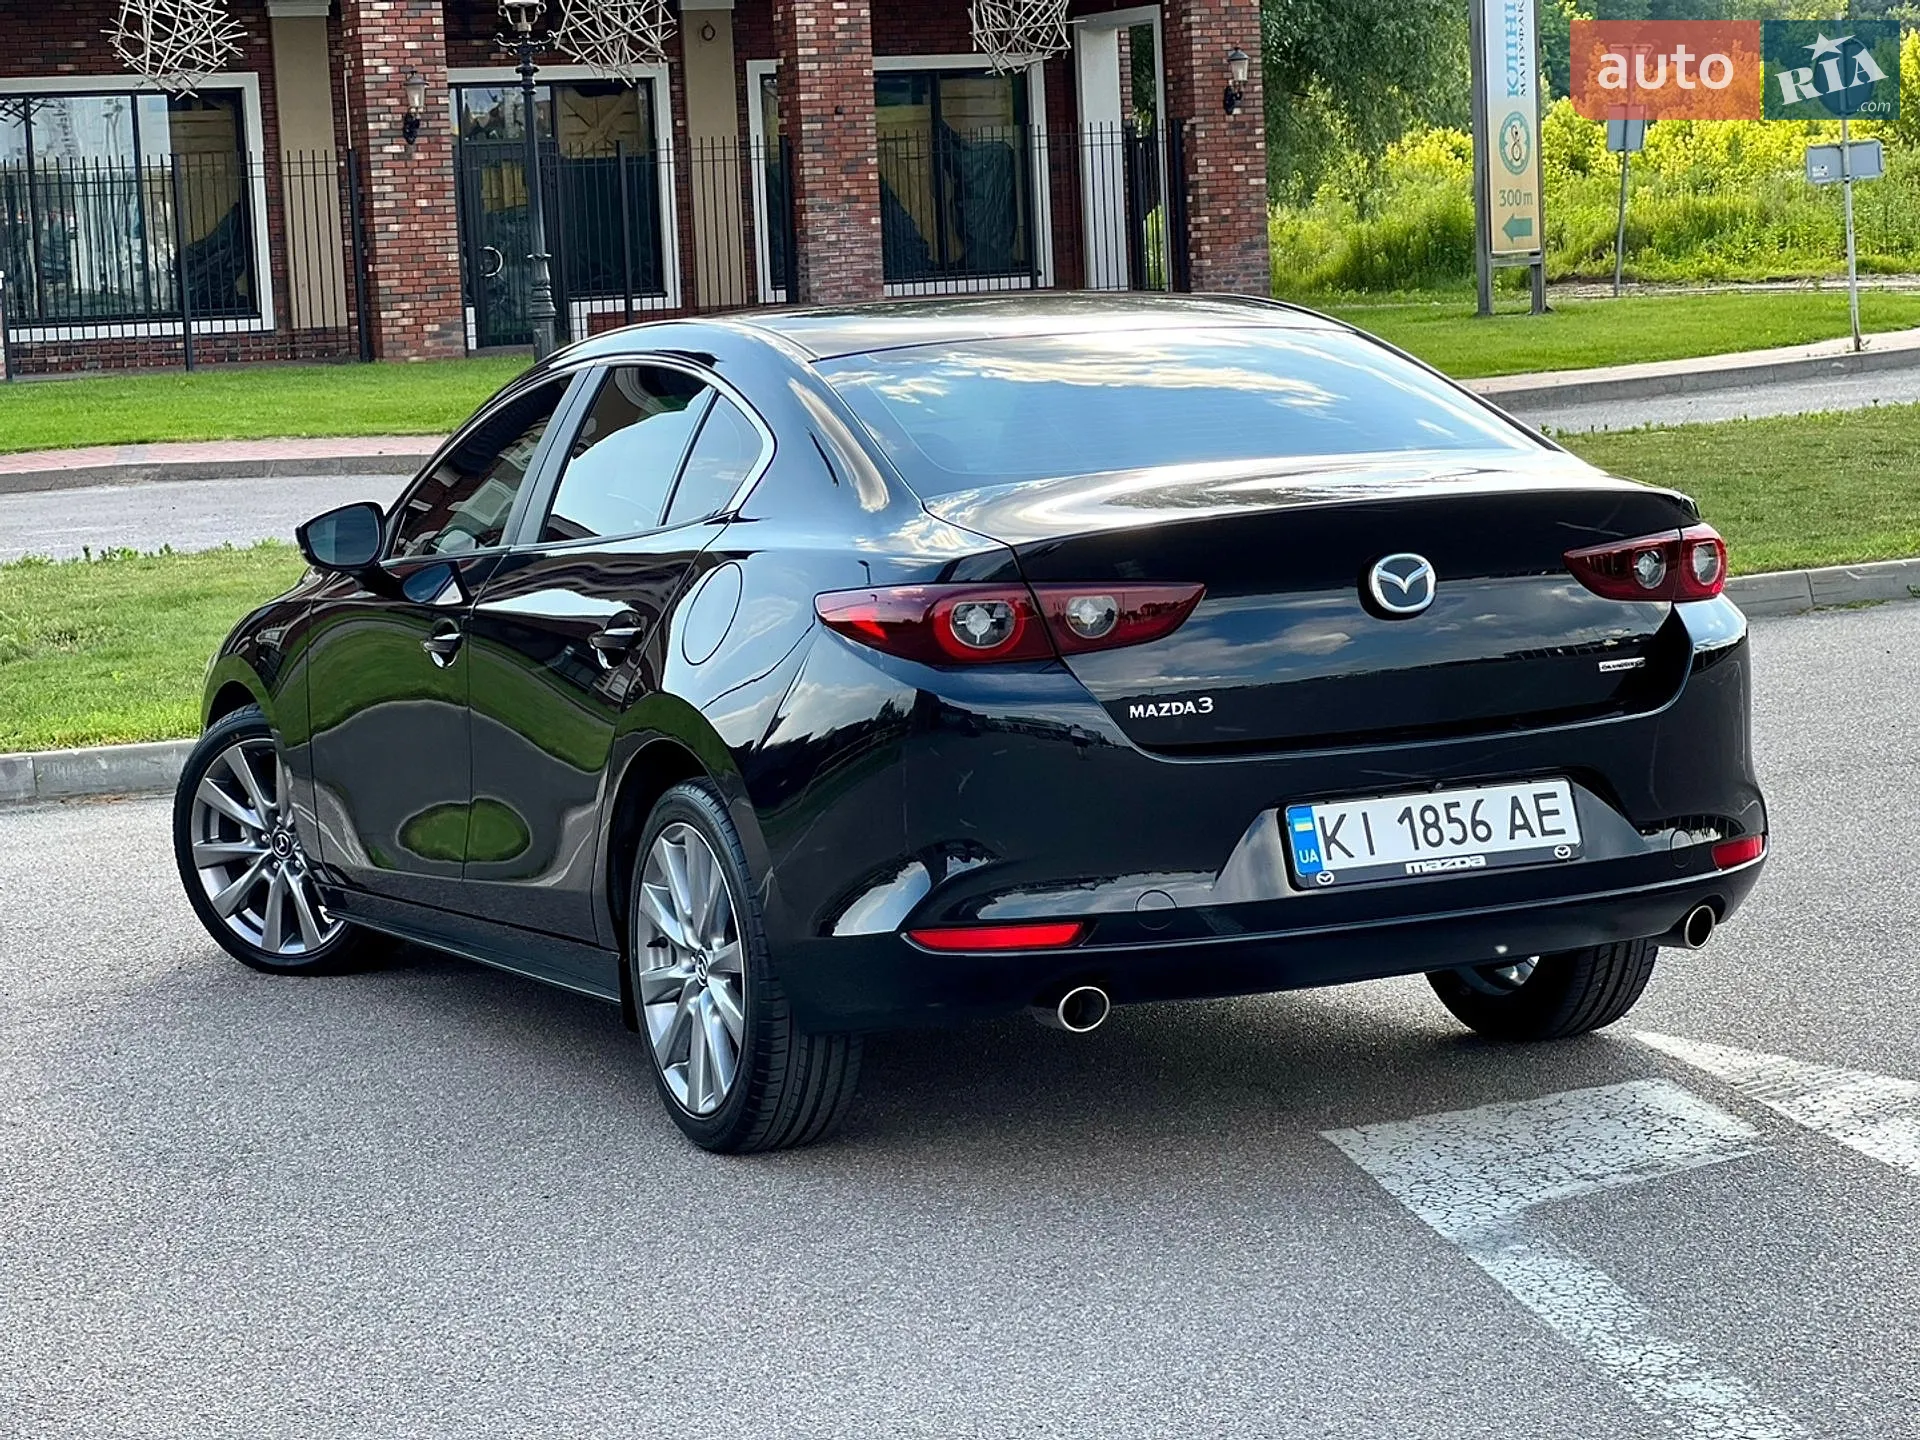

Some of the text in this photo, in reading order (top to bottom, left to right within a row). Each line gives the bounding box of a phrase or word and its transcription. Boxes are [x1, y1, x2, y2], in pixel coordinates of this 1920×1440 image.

[1318, 791, 1567, 861] KI 1856 AE
[1298, 848, 1320, 864] UA
